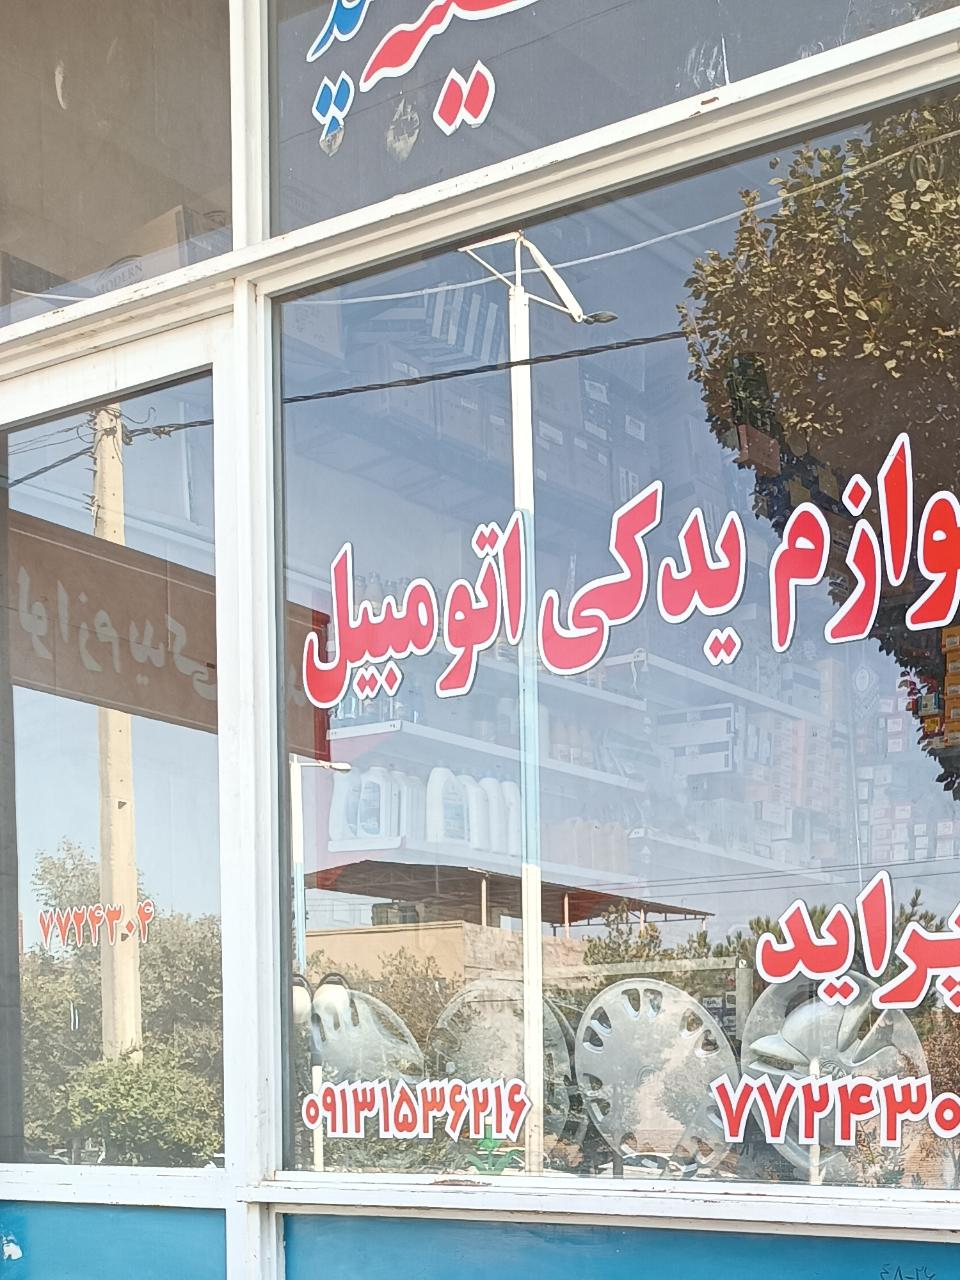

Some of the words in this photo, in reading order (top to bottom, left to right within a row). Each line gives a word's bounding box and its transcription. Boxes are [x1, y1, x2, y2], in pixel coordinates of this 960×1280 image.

[302, 508, 525, 709] اتومبیل
[539, 480, 746, 676] یدکی
[38, 899, 156, 949] ۷۷۲۴۳۰۴
[302, 1075, 529, 1142] ۰۹۱۳۱۵۳۶۲۱۶
